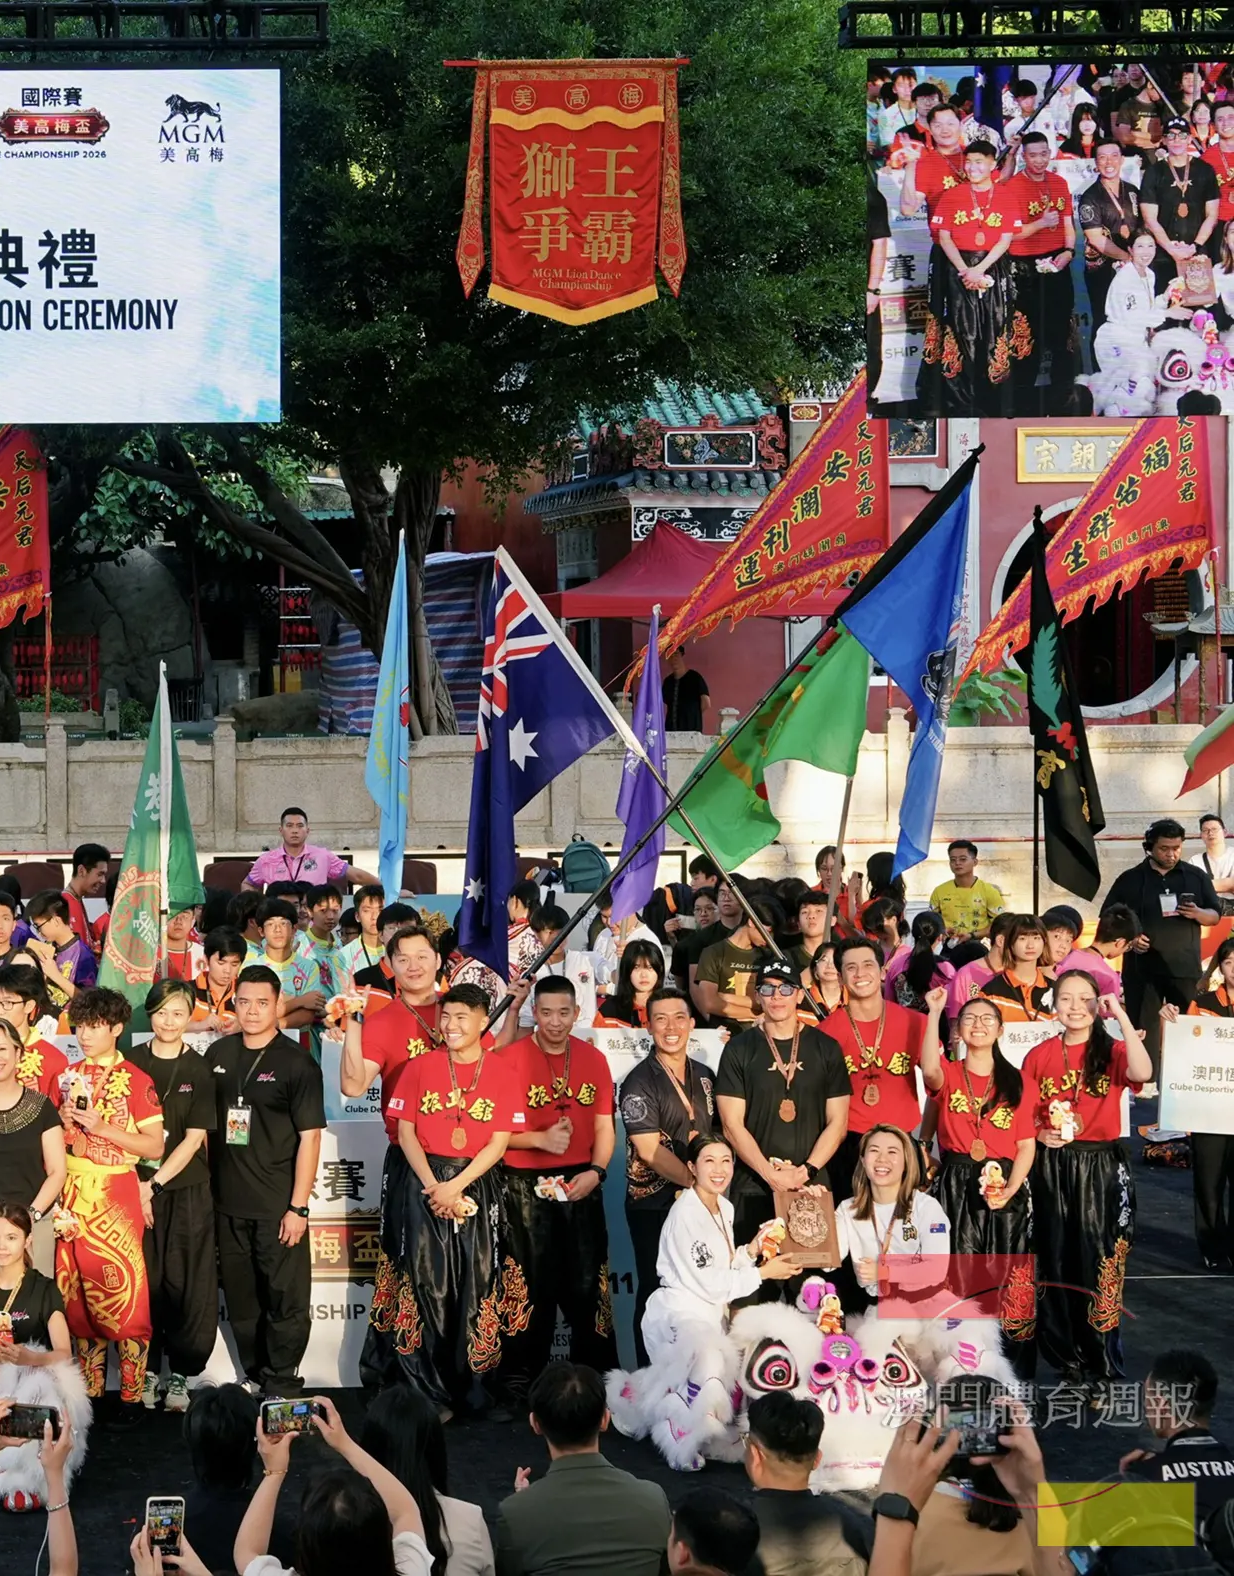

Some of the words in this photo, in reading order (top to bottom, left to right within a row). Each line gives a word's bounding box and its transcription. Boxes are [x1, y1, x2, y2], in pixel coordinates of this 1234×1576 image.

[21, 87, 83, 108] 國際賽
[514, 86, 643, 107] 美高梅
[13, 118, 91, 135] 美高梅盃
[158, 125, 226, 144] MGM
[4, 151, 80, 159] CHAMPIONSHIP
[83, 150, 107, 159] 2026
[160, 147, 225, 163] 美高梅
[519, 142, 639, 200] 獅王
[518, 206, 636, 265] 爭霸
[532, 268, 564, 279] MGM
[566, 268, 589, 280] Lion
[590, 269, 622, 280] Dance
[539, 279, 612, 291] Championship
[42, 298, 179, 331] CEREMONY
[855, 419, 875, 518] 天后元君
[13, 449, 35, 548] 天后元君
[1169, 1082, 1193, 1091] Clube
[344, 1105, 369, 1114] Clube
[370, 1105, 382, 1113] De
[1161, 1459, 1234, 1483] AUSTRA
